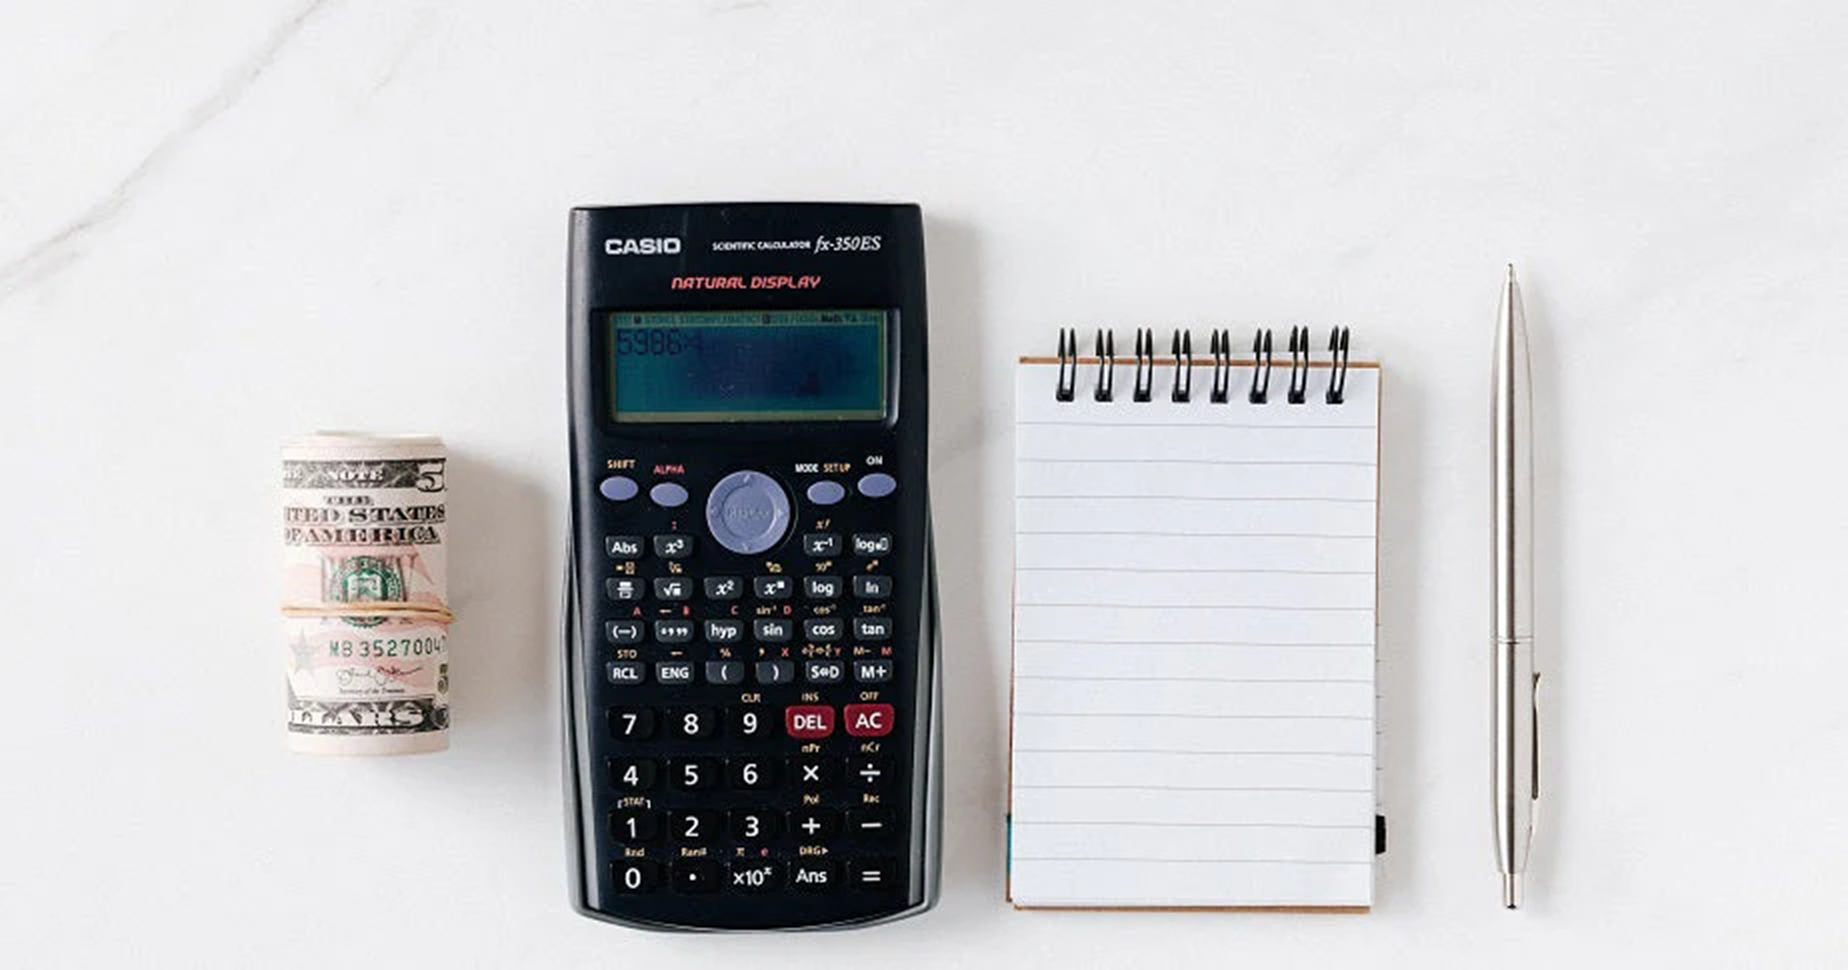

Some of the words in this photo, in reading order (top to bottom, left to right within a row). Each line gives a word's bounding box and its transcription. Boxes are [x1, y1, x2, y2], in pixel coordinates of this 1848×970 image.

[604, 238, 682, 255] CASIO
[814, 235, 881, 254] fx-350ES
[671, 276, 746, 290] NATURAL
[750, 275, 821, 290] DISPLAY
[607, 459, 636, 469] SHIFT
[795, 463, 820, 473] MODE
[865, 456, 883, 466] ON
[328, 469, 385, 482] NOTE
[653, 465, 685, 475] ALPHA
[347, 504, 446, 524] STATES
[304, 526, 440, 546] AMERICA
[611, 541, 638, 554] Abs
[812, 581, 834, 596] log
[865, 581, 879, 594] ln
[633, 606, 641, 616] A
[730, 605, 738, 615] C
[783, 605, 792, 615] D
[711, 623, 737, 639] hyp
[763, 623, 783, 636] sin
[812, 624, 835, 635] cos
[861, 623, 885, 635] tan
[781, 647, 789, 657] X
[881, 646, 892, 656] M
[613, 667, 638, 679] RCL
[661, 667, 689, 679] ENG
[861, 665, 887, 679] M+
[622, 714, 637, 735] 7
[683, 713, 699, 735] 8
[743, 713, 757, 734] 9
[794, 715, 827, 730] DEL
[855, 712, 882, 729] AC
[623, 765, 639, 786] 4
[684, 764, 699, 785] 5
[743, 763, 758, 785] 6
[626, 817, 636, 838] 1
[685, 815, 699, 837] 2
[745, 815, 759, 837] 3
[625, 867, 641, 889] 0
[795, 868, 828, 884] Ans
